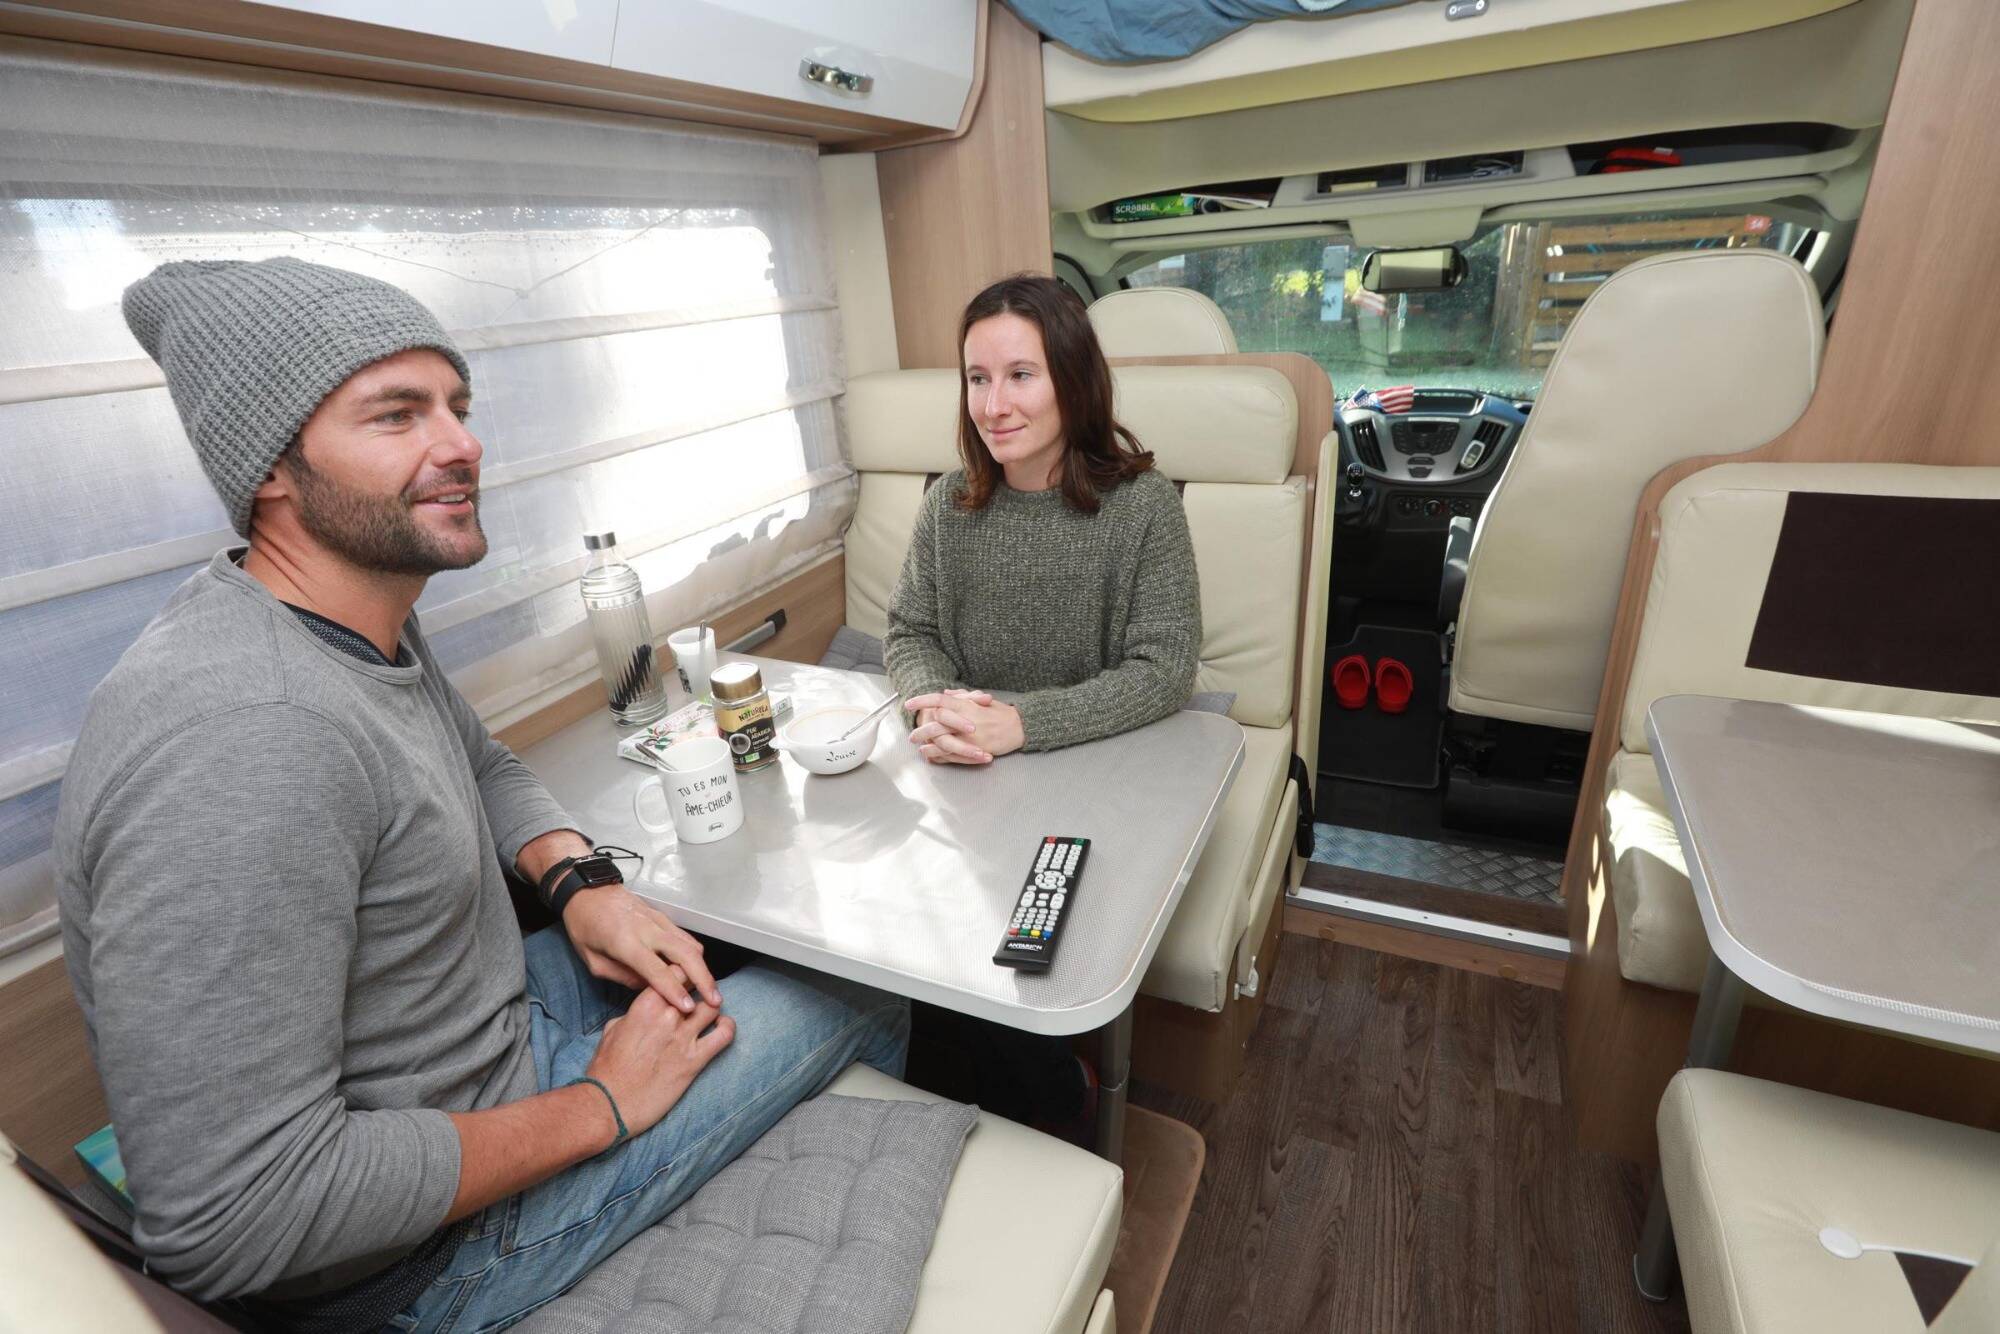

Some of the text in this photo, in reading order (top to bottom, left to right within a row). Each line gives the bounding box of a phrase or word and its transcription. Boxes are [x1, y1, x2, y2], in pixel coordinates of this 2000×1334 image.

[1116, 204, 1155, 213] SCRABBLE
[677, 774, 728, 797] TU ES MON
[685, 791, 733, 816] ÂME-CHIEUR
